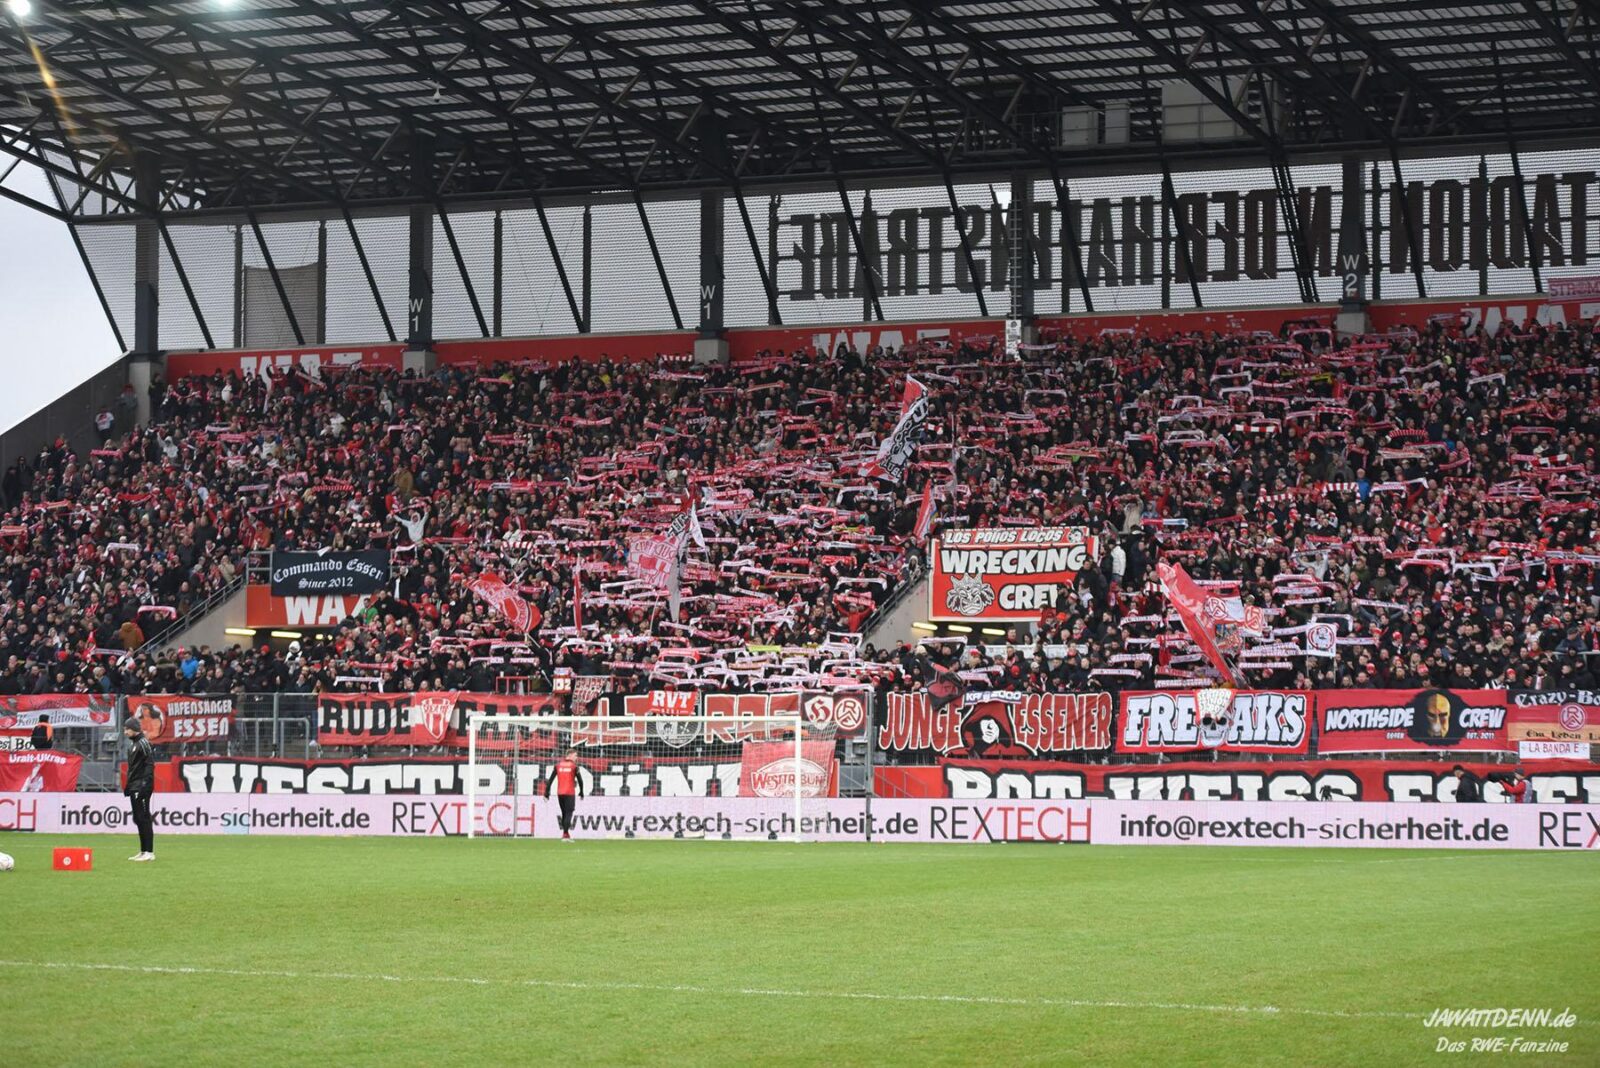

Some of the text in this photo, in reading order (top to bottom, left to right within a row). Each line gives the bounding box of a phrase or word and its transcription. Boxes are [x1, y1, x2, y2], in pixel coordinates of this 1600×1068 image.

[700, 285, 716, 299] W
[408, 298, 423, 313] W
[704, 303, 712, 319] 1
[946, 531, 971, 544] LOS
[1021, 529, 1064, 543] LOCOS
[940, 545, 1086, 574] WRECKING
[273, 560, 342, 583] Commando
[298, 577, 354, 589] Since 2012
[999, 583, 1058, 610] CRE
[651, 691, 692, 708] RVT
[173, 717, 229, 738] ESSEN
[320, 699, 411, 735] RUDE
[879, 691, 1112, 753] JUNGE ESSENER
[1325, 708, 1505, 731] NORTHSIDE CREW
[1543, 743, 1571, 753] BANDA
[61, 803, 370, 830] info@rxtech-sicherheit.de
[392, 802, 535, 834] REXTECH
[931, 805, 1091, 841] REXTECH
[1120, 813, 1508, 844] info@rextech-sicherheit.de
